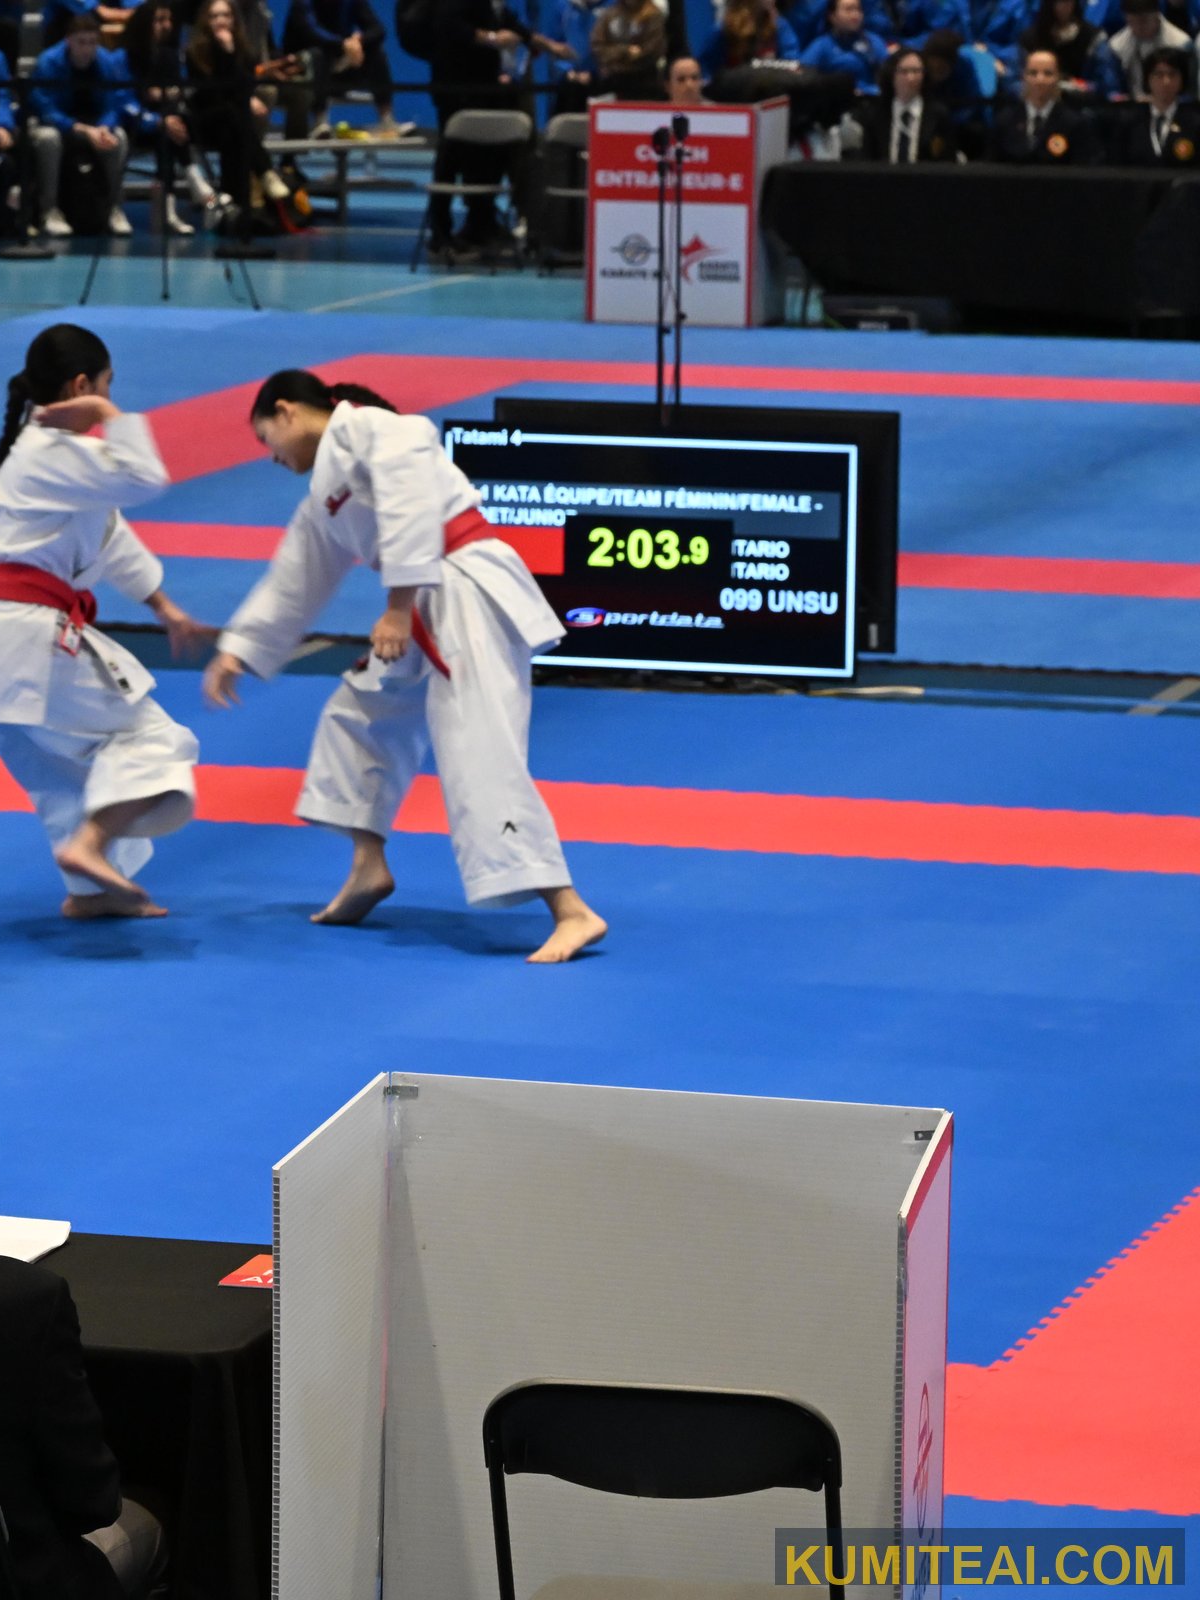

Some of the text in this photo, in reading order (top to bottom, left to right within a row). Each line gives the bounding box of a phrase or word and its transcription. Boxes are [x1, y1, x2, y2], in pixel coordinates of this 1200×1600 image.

[452, 427, 522, 446] Tatami 4
[493, 484, 541, 503] KATA
[587, 527, 709, 570] 2:03.9
[731, 539, 791, 559] TARIO
[731, 561, 790, 582] TARIO
[719, 587, 838, 615] 099 UNSU
